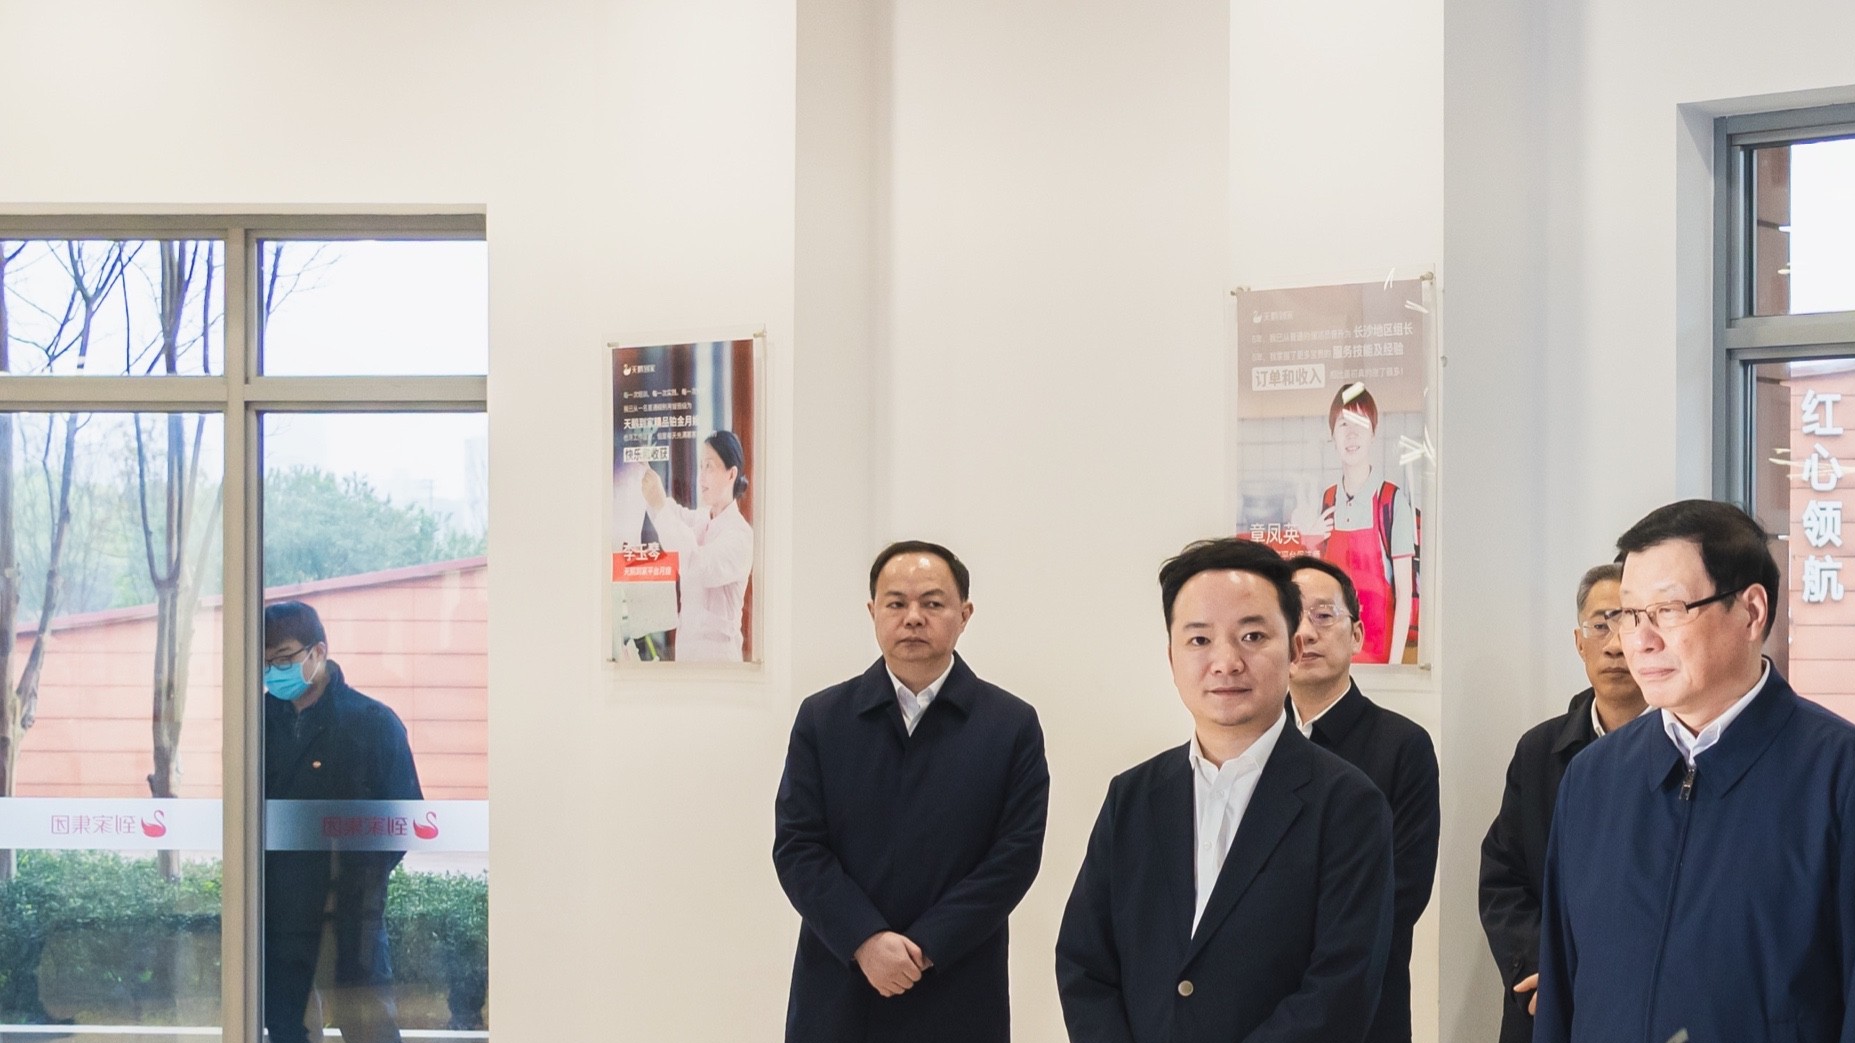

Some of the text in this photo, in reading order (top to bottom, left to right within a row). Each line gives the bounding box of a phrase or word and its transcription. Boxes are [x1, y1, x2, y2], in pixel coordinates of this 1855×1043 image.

[1353, 322, 1413, 338] 长沙地区组长
[1332, 342, 1404, 359] 服务技能及经验
[1255, 367, 1321, 387] 订单和收入
[625, 447, 668, 460] 快乐收获
[1801, 389, 1844, 603] 红心领航
[1250, 523, 1300, 545] 章凤英
[623, 542, 661, 561] 李玉琴
